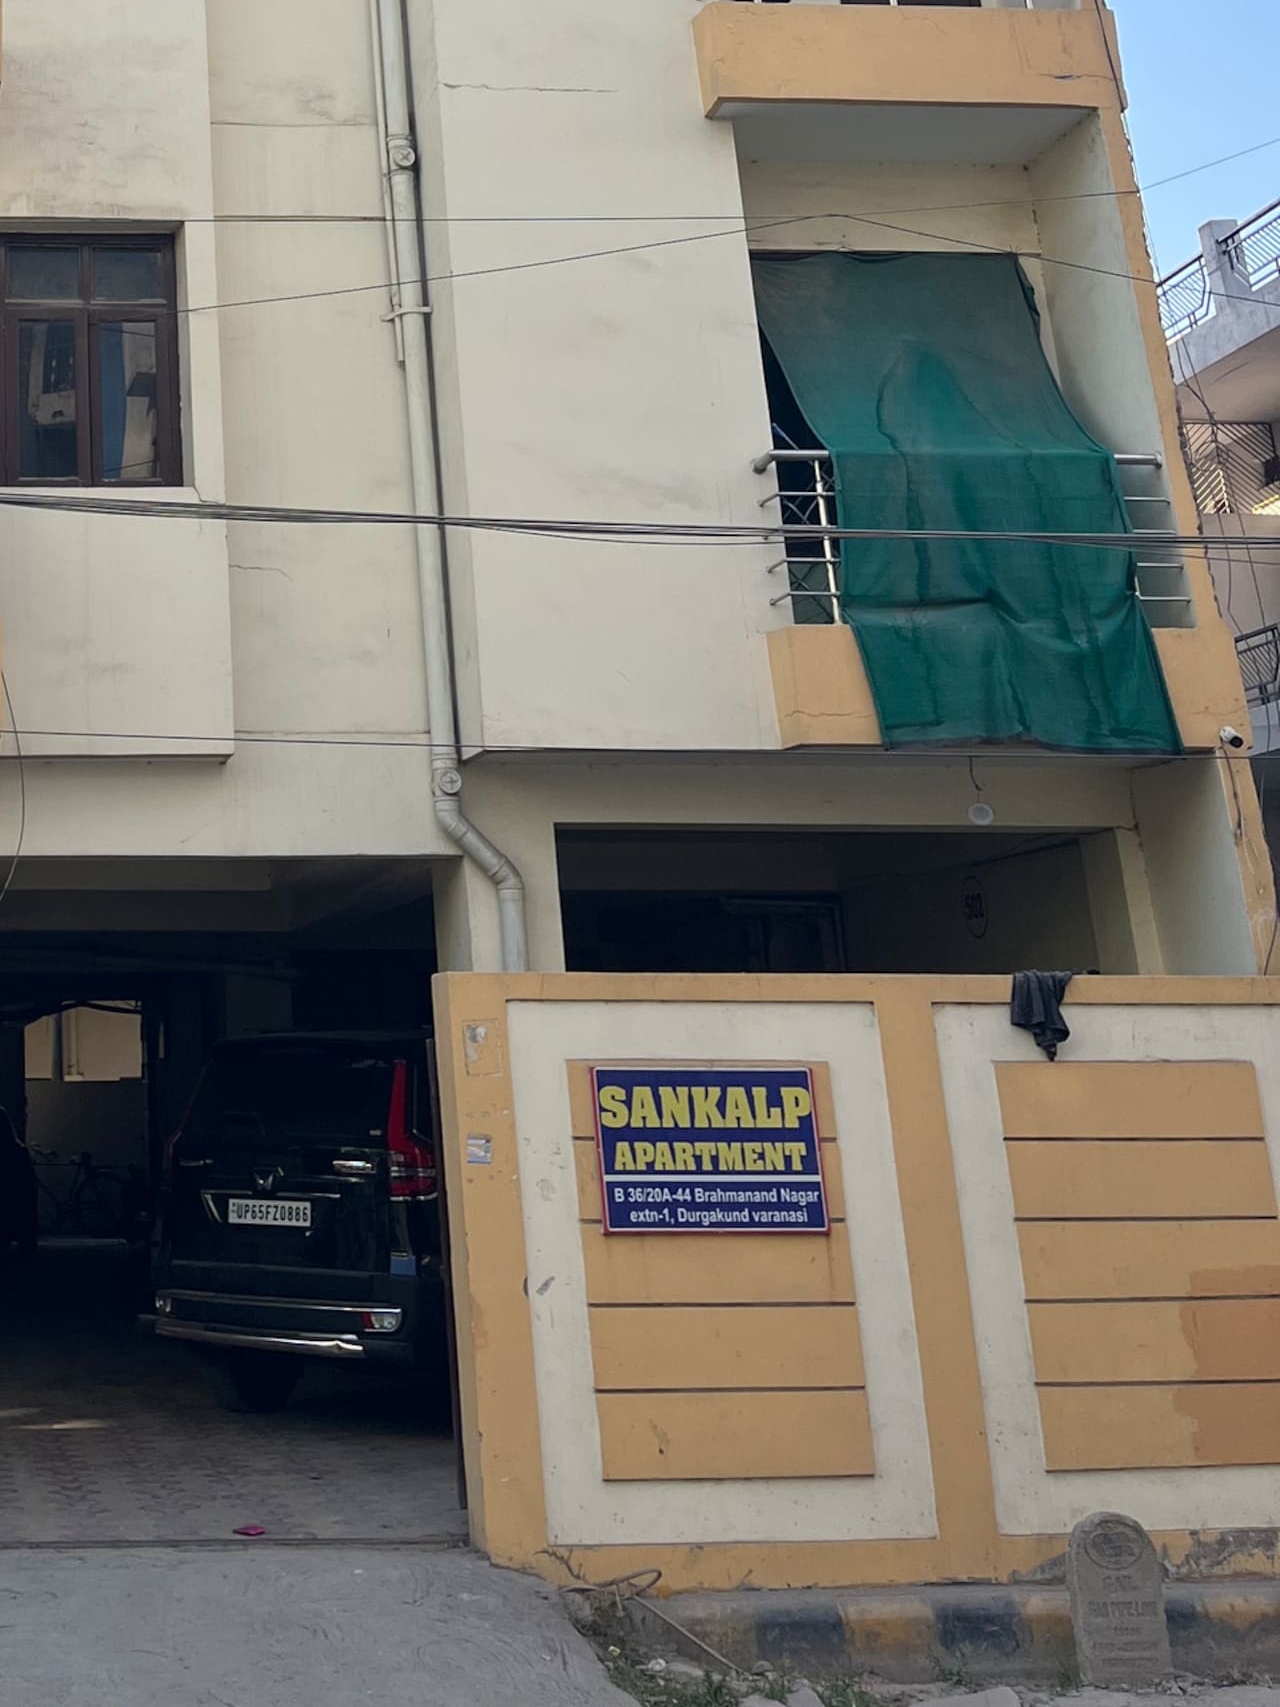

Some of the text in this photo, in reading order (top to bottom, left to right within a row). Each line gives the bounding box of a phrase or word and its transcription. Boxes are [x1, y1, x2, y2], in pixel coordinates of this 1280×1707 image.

[599, 1086, 812, 1128] SANKALP
[614, 1141, 807, 1171] APARTMENT
[614, 1187, 819, 1206] B 36/20A-44 Brahmanand Nagar
[236, 1203, 309, 1222] UP65FZ0886
[630, 1207, 809, 1226] extn-1, Durgakund varanasi
